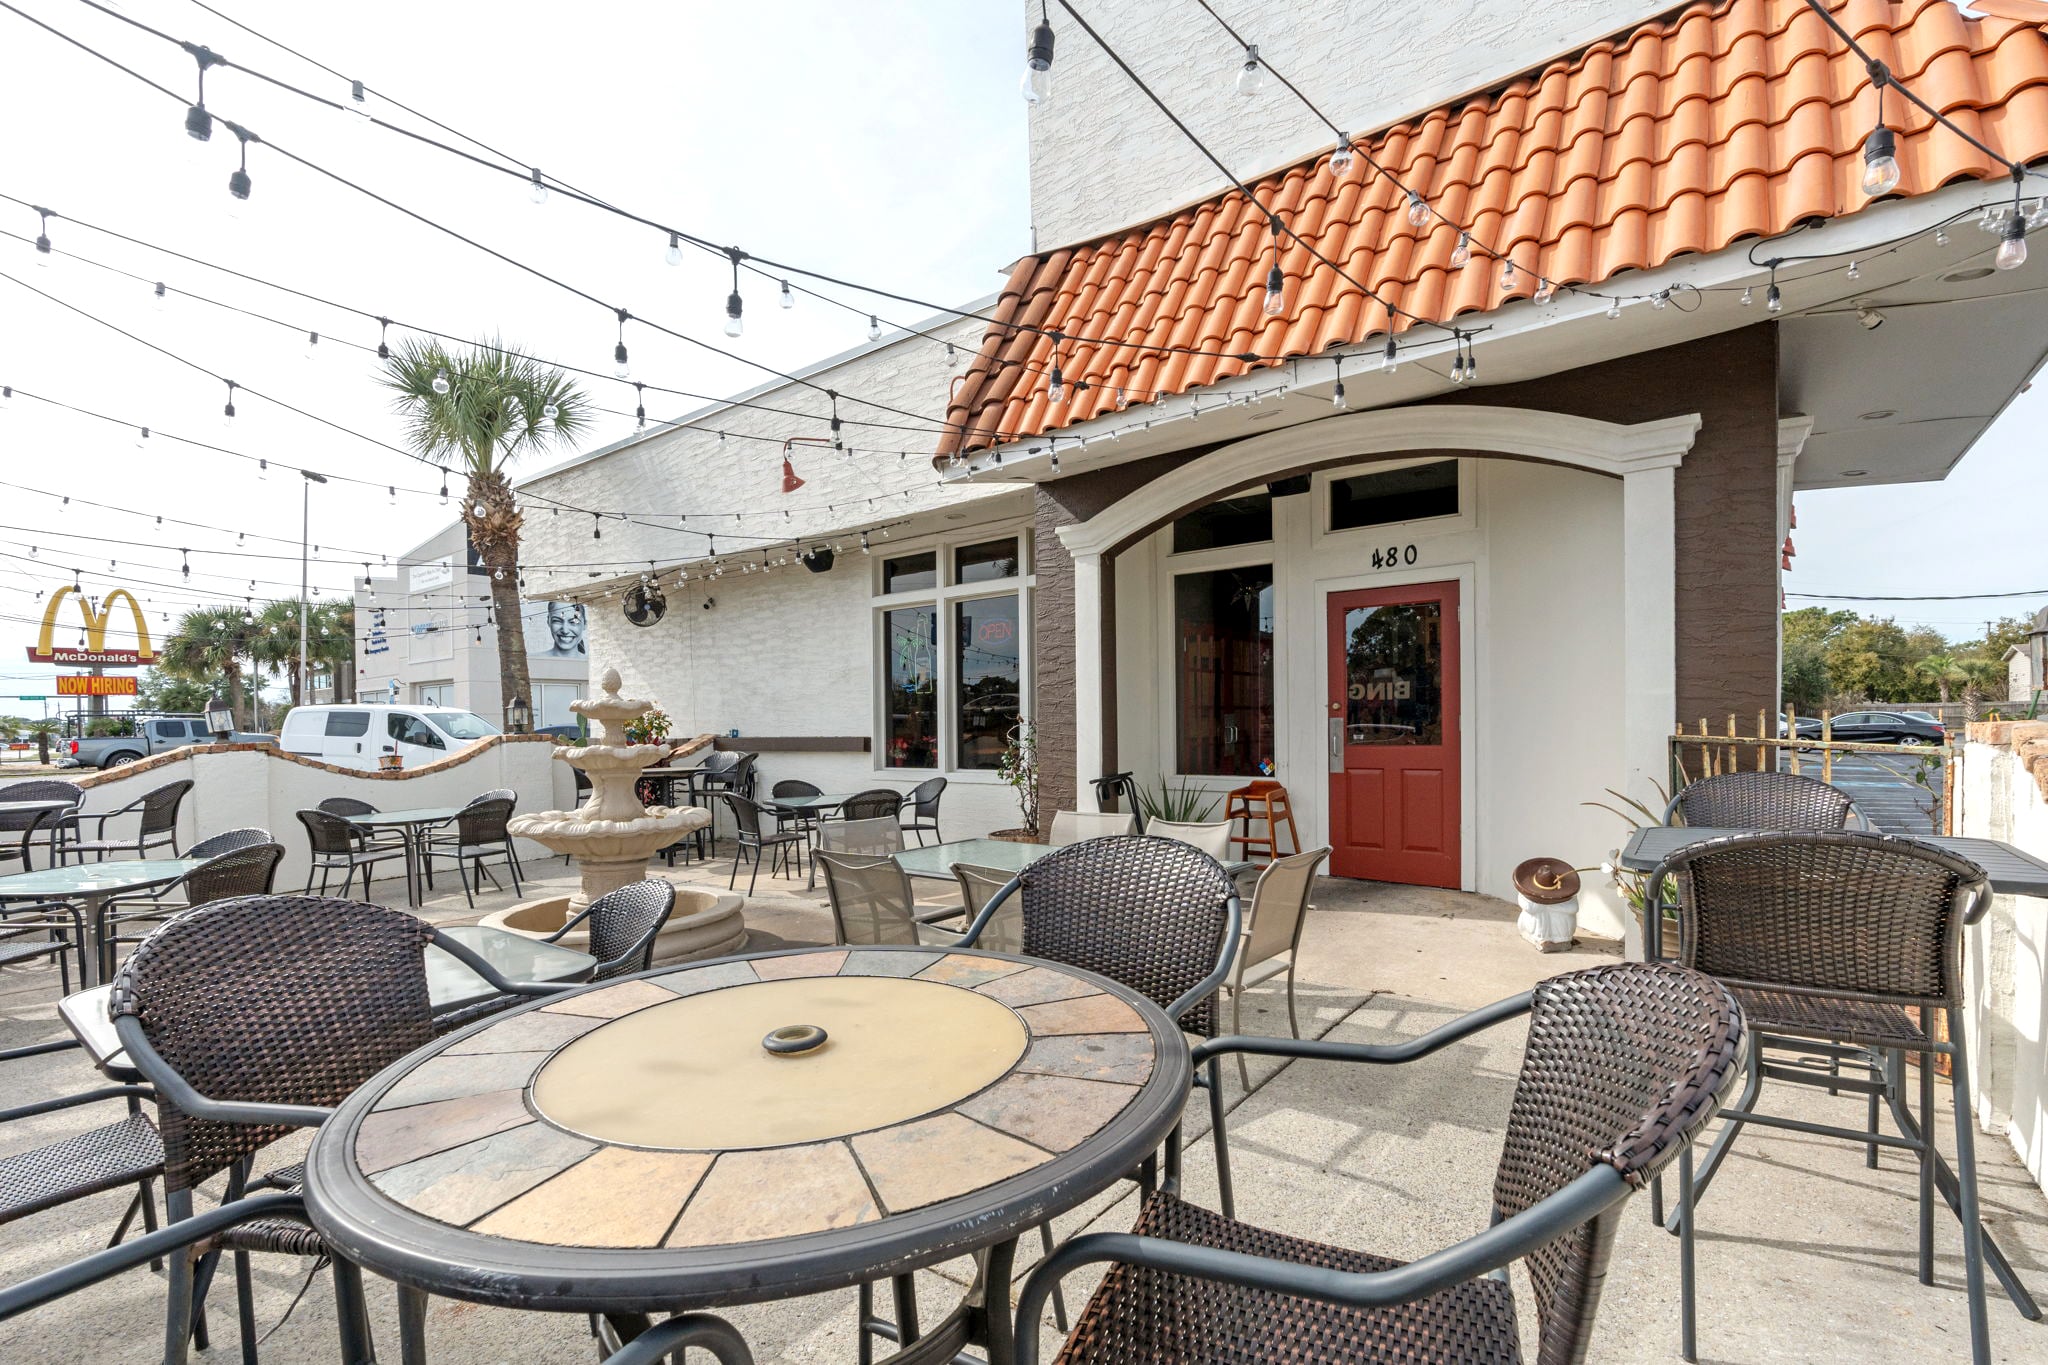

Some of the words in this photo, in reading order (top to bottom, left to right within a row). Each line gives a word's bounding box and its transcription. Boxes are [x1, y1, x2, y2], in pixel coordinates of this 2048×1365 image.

[1371, 545, 1418, 570] 480
[978, 621, 1012, 641] OPEN
[54, 652, 137, 663] McDonald's
[58, 677, 88, 694] NOW
[91, 677, 135, 694] HIRING
